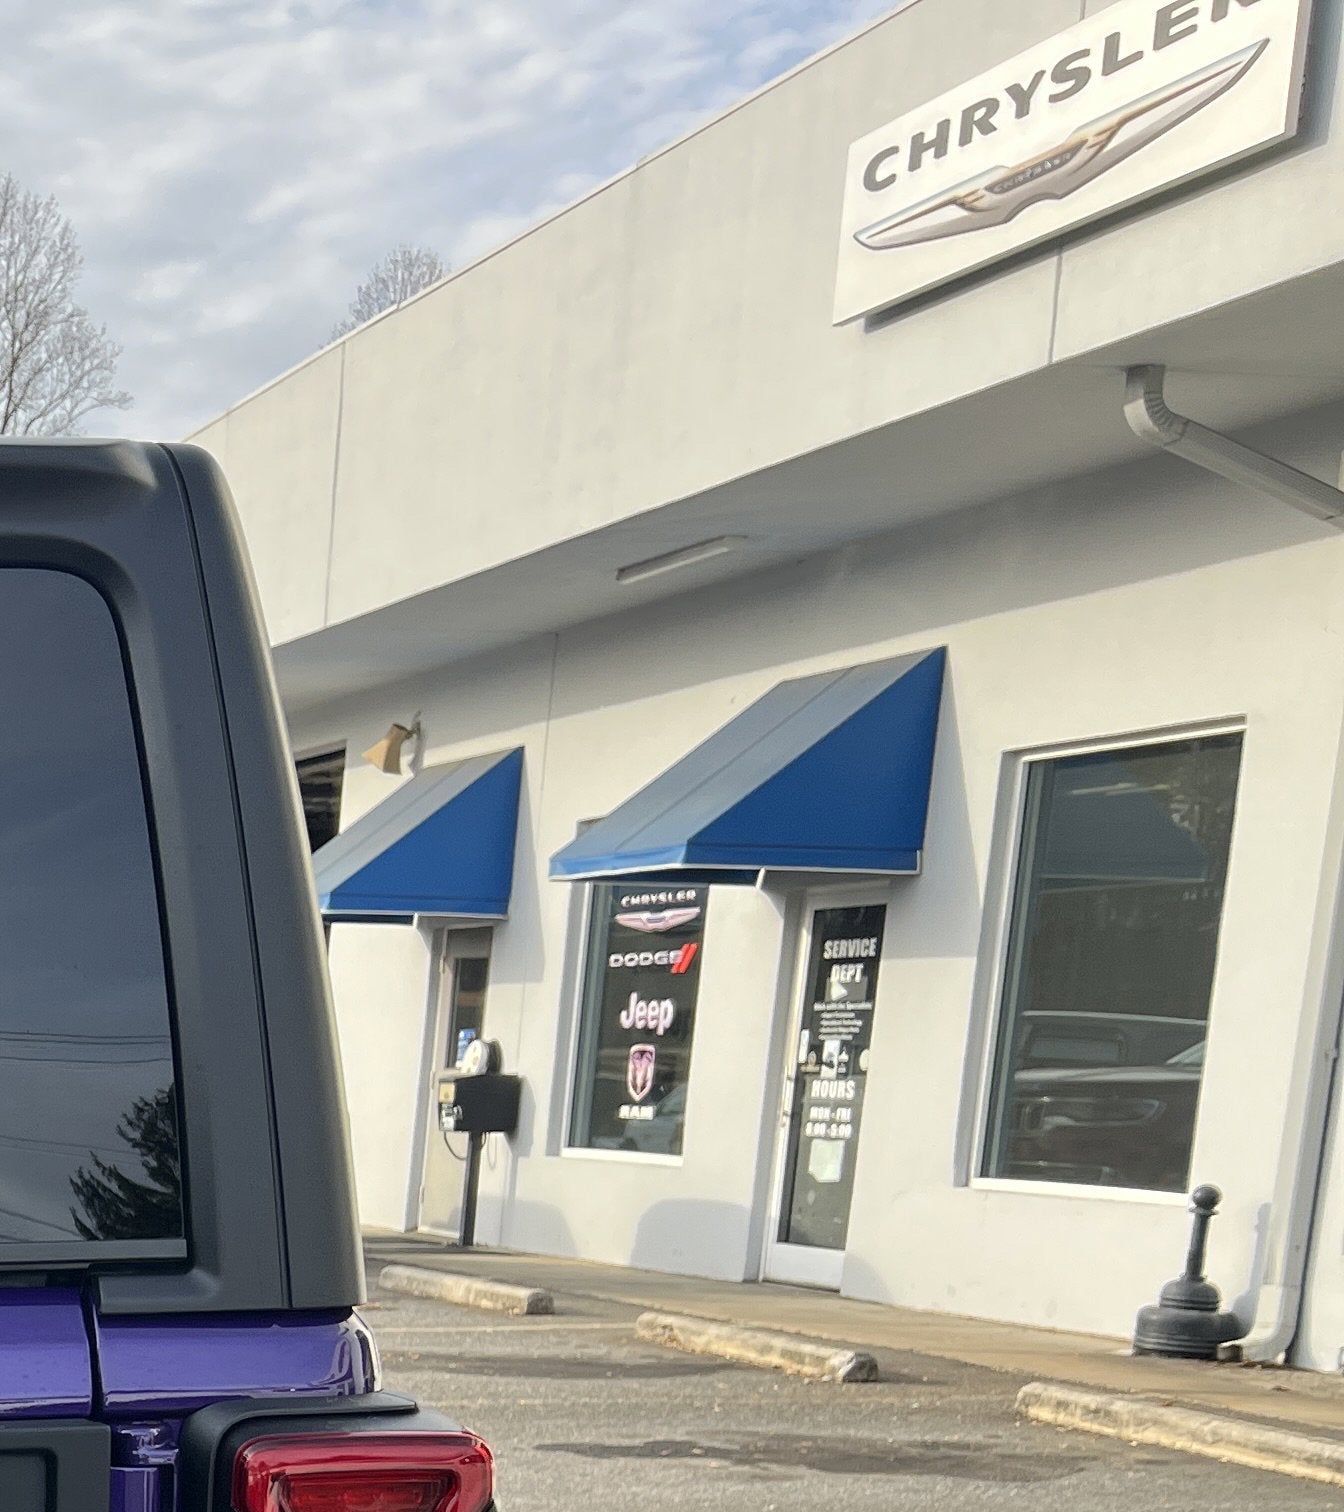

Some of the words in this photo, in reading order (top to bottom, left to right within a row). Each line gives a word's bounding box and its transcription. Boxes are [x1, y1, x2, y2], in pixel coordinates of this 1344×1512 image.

[620, 889, 696, 908] CHRYSLER
[609, 949, 683, 968] DODGE
[823, 937, 877, 960] SERVICE
[830, 963, 864, 983] DEPT
[620, 991, 674, 1036] Jeep
[811, 1080, 855, 1100] HOURS
[618, 1105, 655, 1120] RAM
